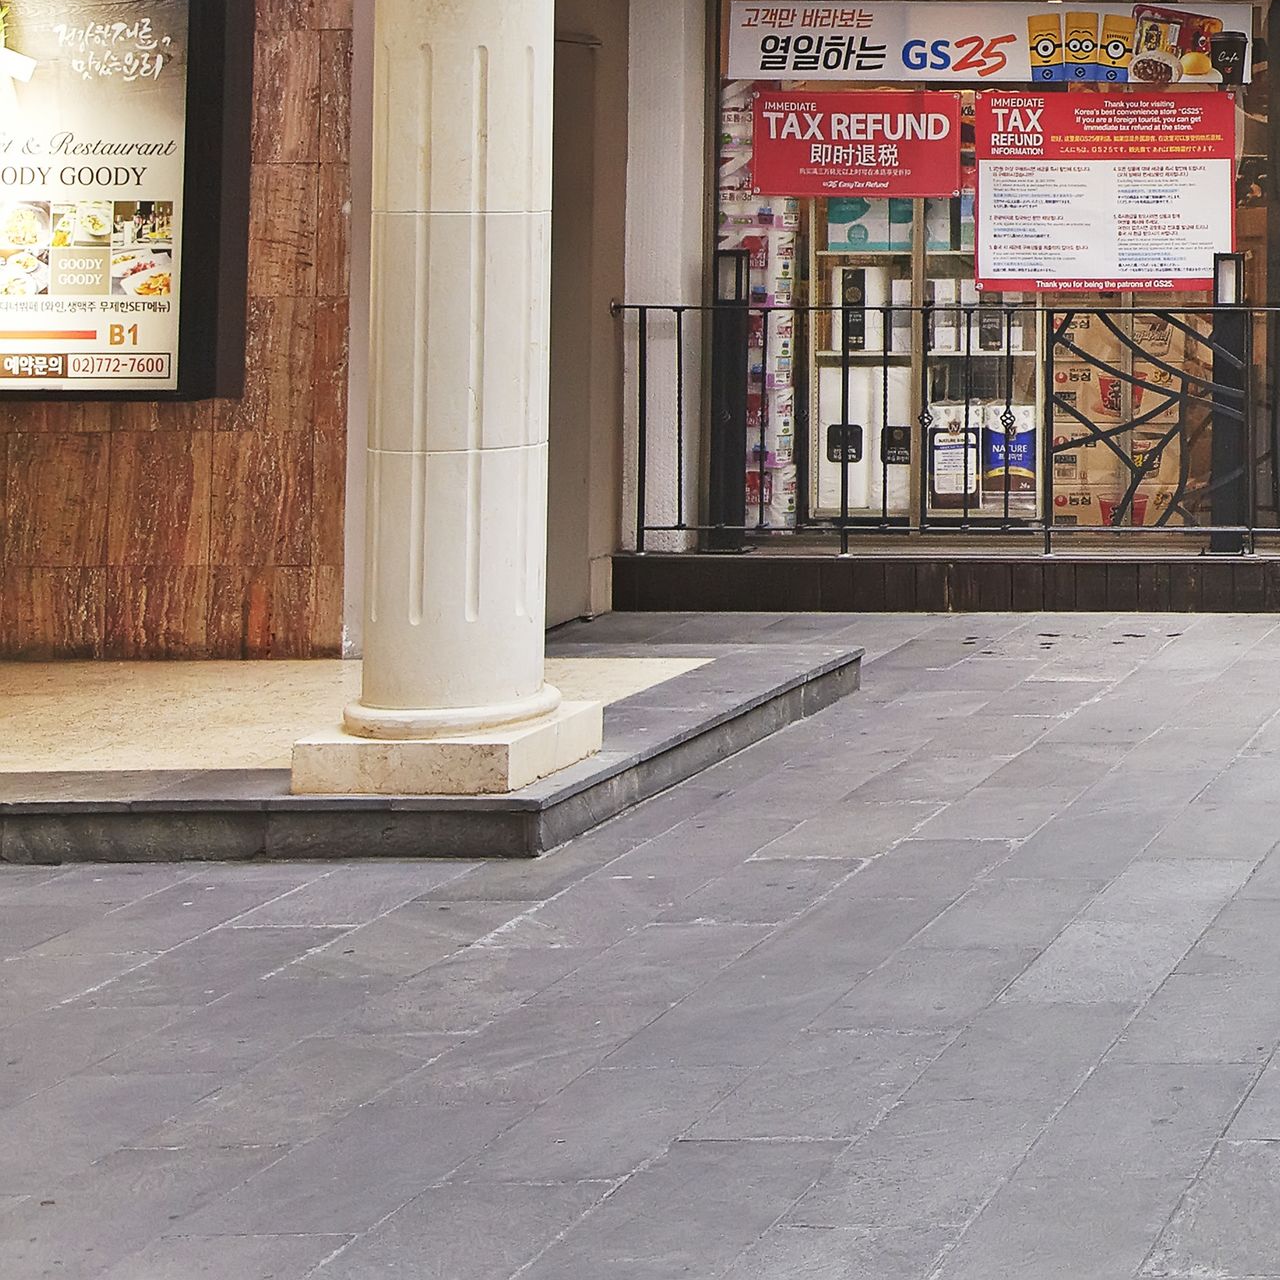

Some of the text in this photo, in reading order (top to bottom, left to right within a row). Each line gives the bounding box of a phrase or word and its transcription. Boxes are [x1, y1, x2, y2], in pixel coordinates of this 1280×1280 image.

[742, 8, 874, 29] 고객만 바라보는
[759, 34, 1018, 77] 열일하는 GS25
[764, 101, 817, 111] IMMEDIATE
[991, 98, 1044, 107] IMMEDIATE
[1104, 100, 1175, 110] Thank you for visiting
[1101, 108, 1117, 116] best
[763, 112, 950, 140] TAX REFUND
[992, 109, 1043, 132] TAX
[1076, 116, 1080, 124] If
[1082, 118, 1093, 126] you
[1113, 116, 1136, 126] foreign
[1138, 116, 1161, 124] tourist,
[1162, 118, 1173, 126] you
[1188, 117, 1202, 126] get
[1131, 124, 1153, 132] refund
[1162, 124, 1172, 132] the
[49, 131, 178, 157] Restaurant
[991, 133, 1043, 146] REFUND
[810, 143, 900, 167] 即时退税
[59, 166, 148, 187] GOODY
[58, 258, 103, 270] GOODY
[58, 273, 103, 286] GOODY
[1036, 280, 1174, 290] Thank you for being the patrons of GS25.
[109, 324, 138, 345] B1
[4, 355, 164, 376] 예약문의 02)772-7600
[1069, 372, 1091, 382] 농심
[1069, 495, 1091, 506] 농심
